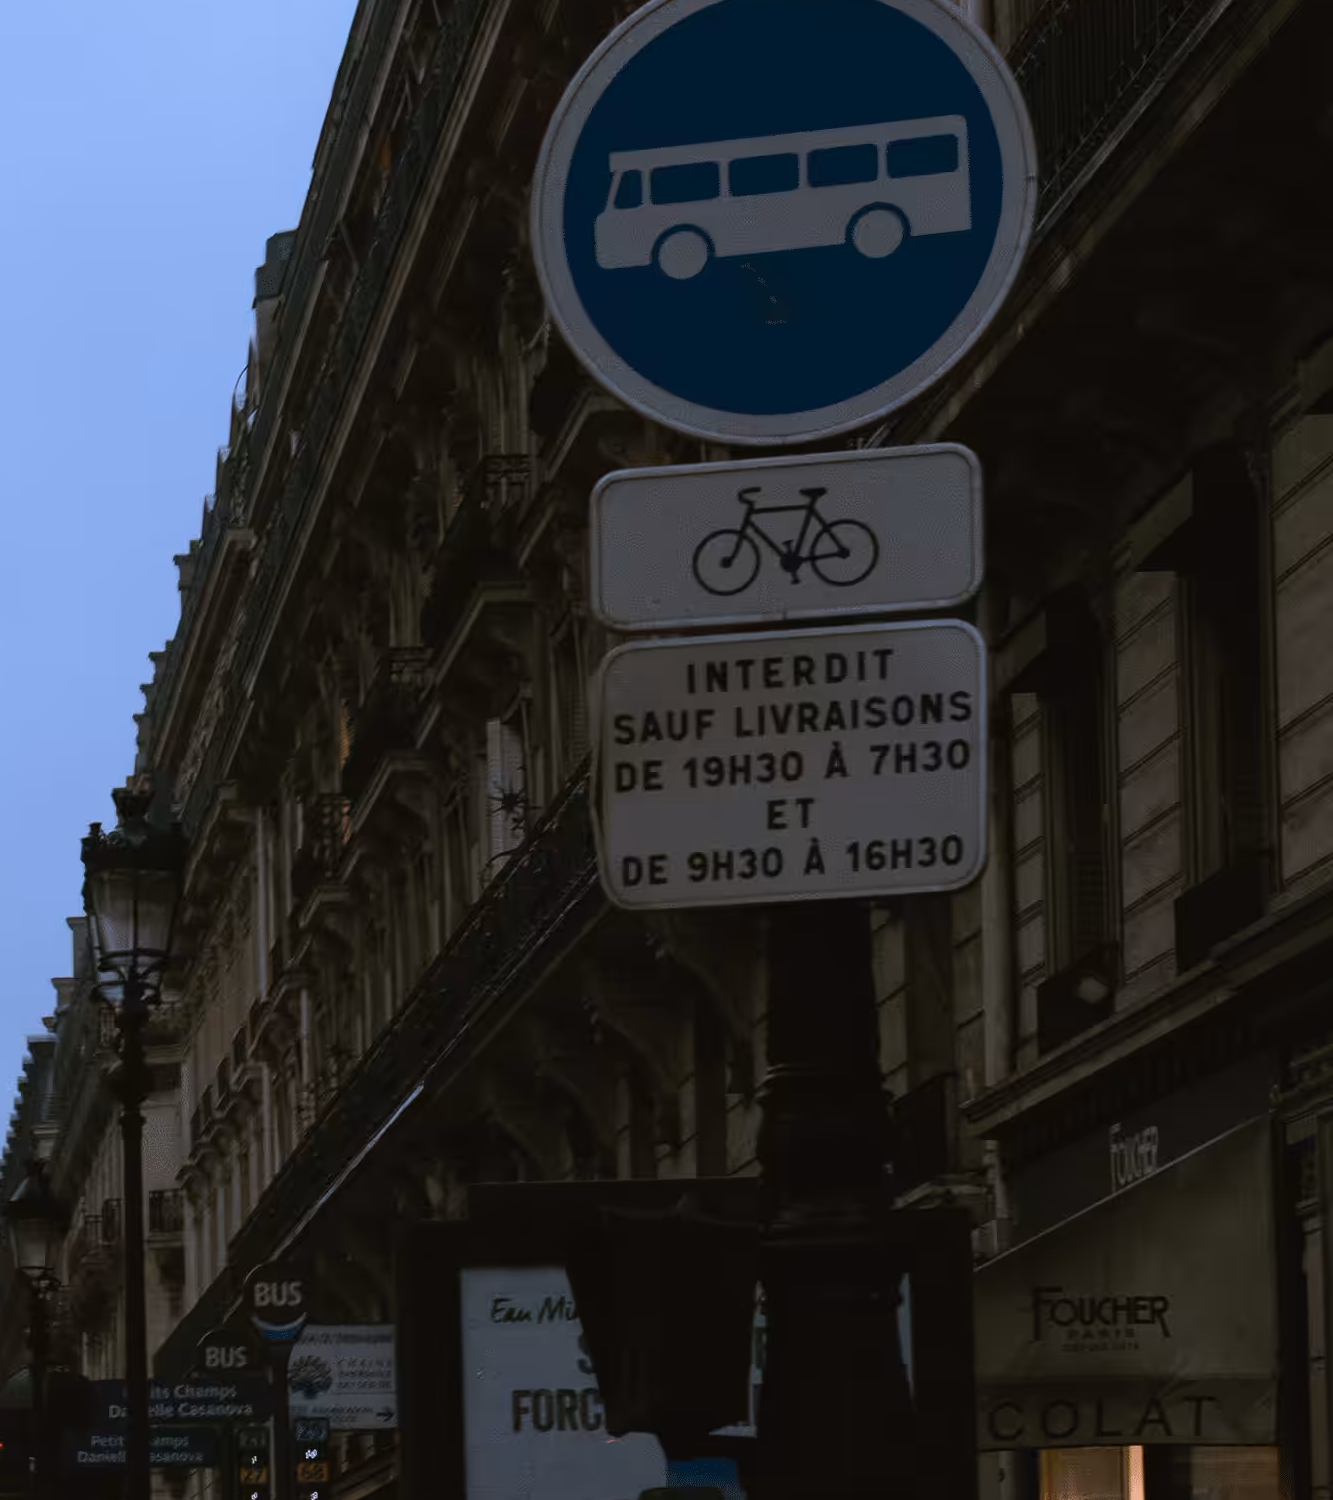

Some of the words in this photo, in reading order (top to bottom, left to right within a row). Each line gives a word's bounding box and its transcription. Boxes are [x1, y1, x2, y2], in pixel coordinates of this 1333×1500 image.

[687, 648, 895, 695] INTERDIT
[613, 708, 715, 746] SAUF
[735, 691, 973, 739] LIVRAISONS
[615, 760, 663, 794] DE
[683, 750, 804, 789] 19H30
[825, 740, 849, 779] À
[870, 739, 971, 776] 7H30
[766, 797, 816, 831] ET
[622, 853, 669, 887] DE
[687, 847, 784, 883] 9H30
[804, 838, 826, 876] À
[845, 834, 964, 873] 16H30
[253, 1281, 303, 1308] BUS
[205, 1345, 248, 1369] BUS
[77, 1449, 127, 1463] Daniell
[90, 1435, 126, 1448] Petit
